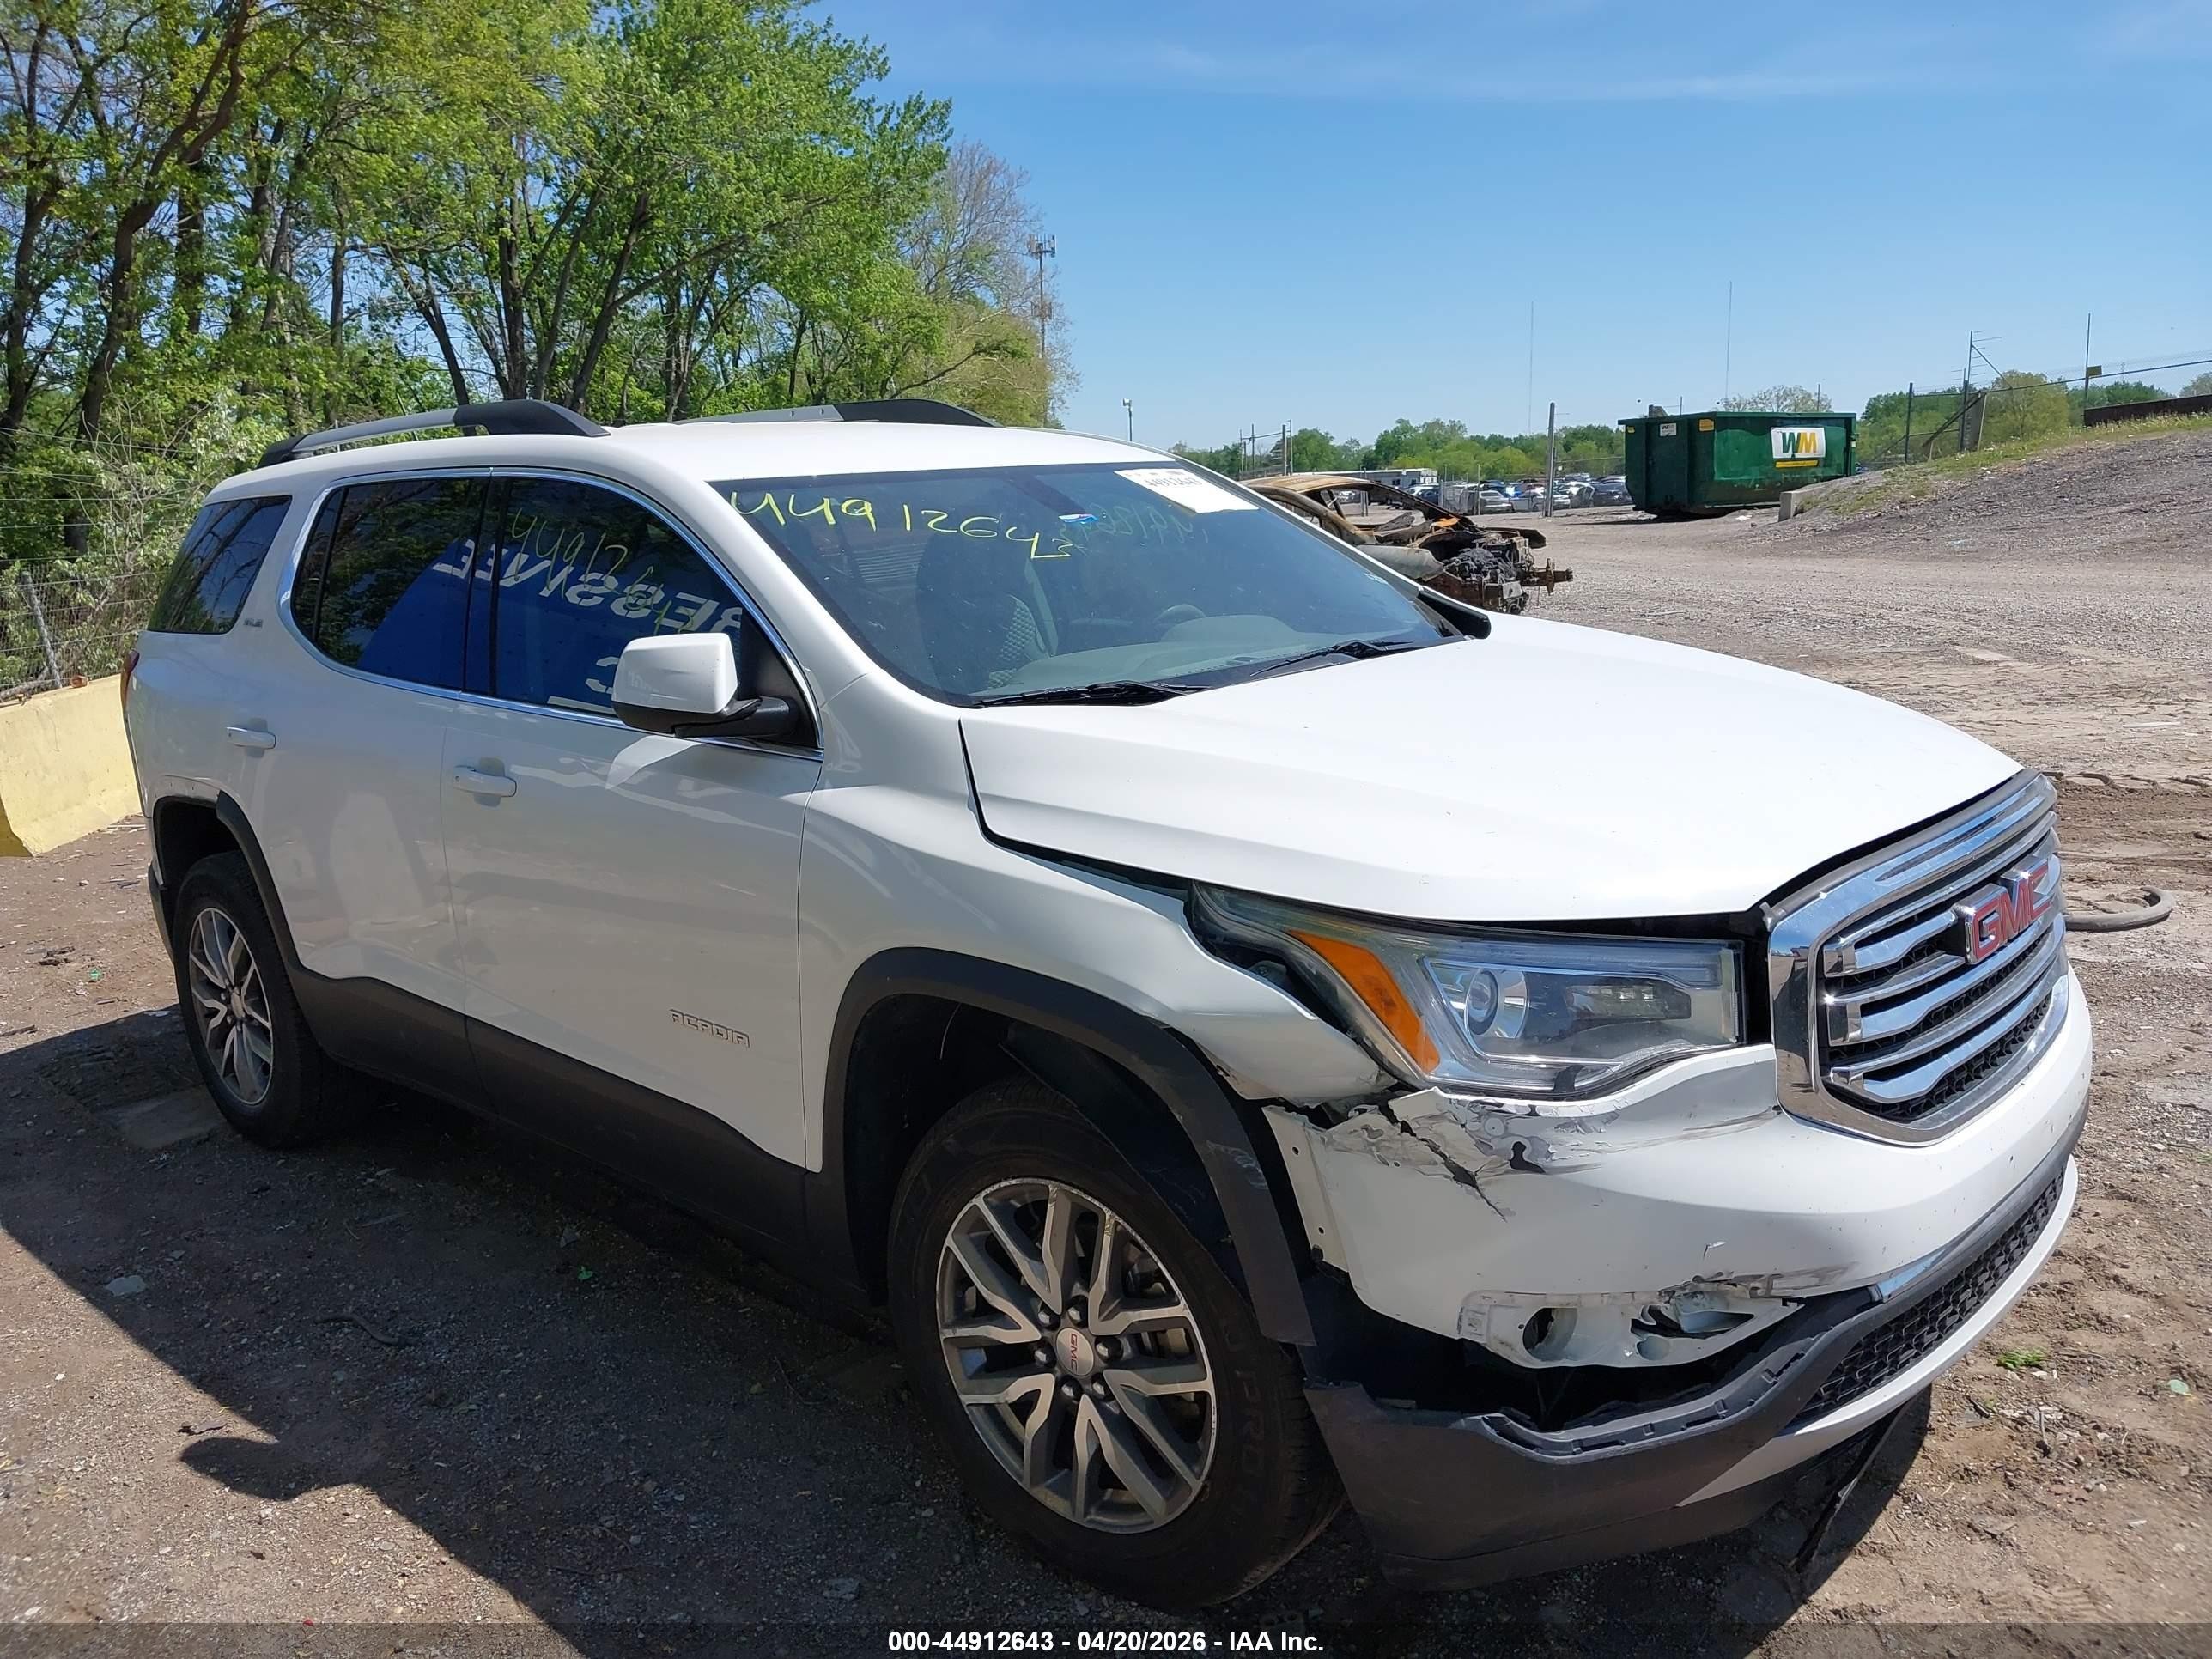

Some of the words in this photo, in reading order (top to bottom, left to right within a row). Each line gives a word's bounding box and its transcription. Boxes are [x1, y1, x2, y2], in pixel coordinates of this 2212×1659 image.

[1781, 432, 1817, 453] WM
[1969, 859, 2053, 963] GMC
[668, 1008, 750, 1048] ACADIA
[1070, 1333, 1079, 1374] GMC
